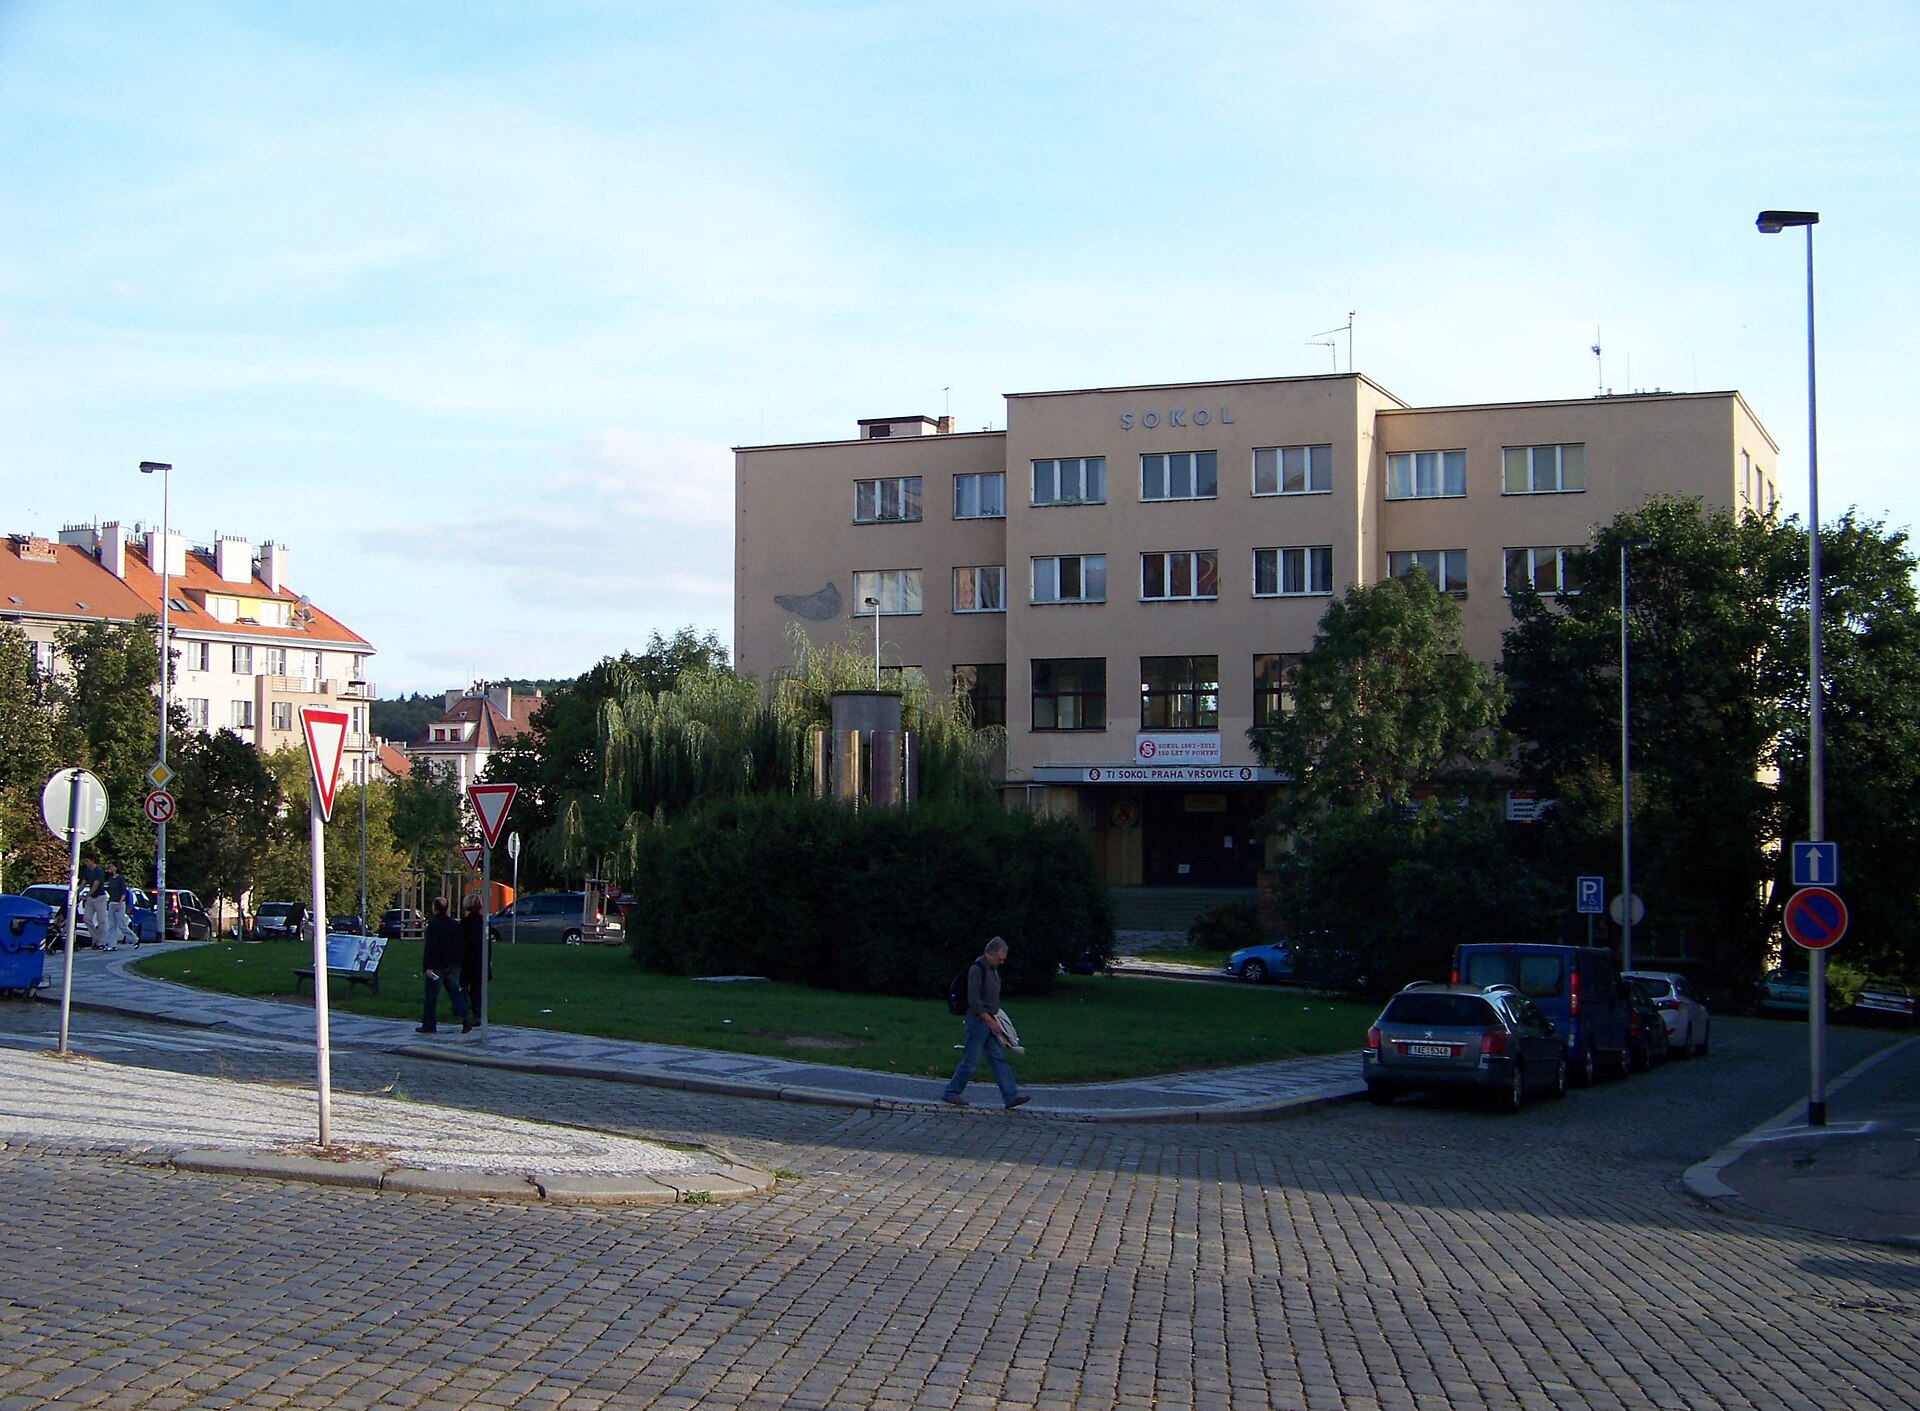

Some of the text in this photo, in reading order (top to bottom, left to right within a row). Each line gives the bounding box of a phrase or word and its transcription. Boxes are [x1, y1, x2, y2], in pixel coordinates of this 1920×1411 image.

[1120, 406, 1235, 430] SOKOL
[1107, 770, 1115, 779] TJ
[1119, 770, 1148, 779] SOKOL
[1151, 770, 1183, 779] PRAHA
[1187, 768, 1234, 779] VRŠOVICE
[1583, 881, 1597, 901] P
[1413, 1046, 1426, 1054] 1AE
